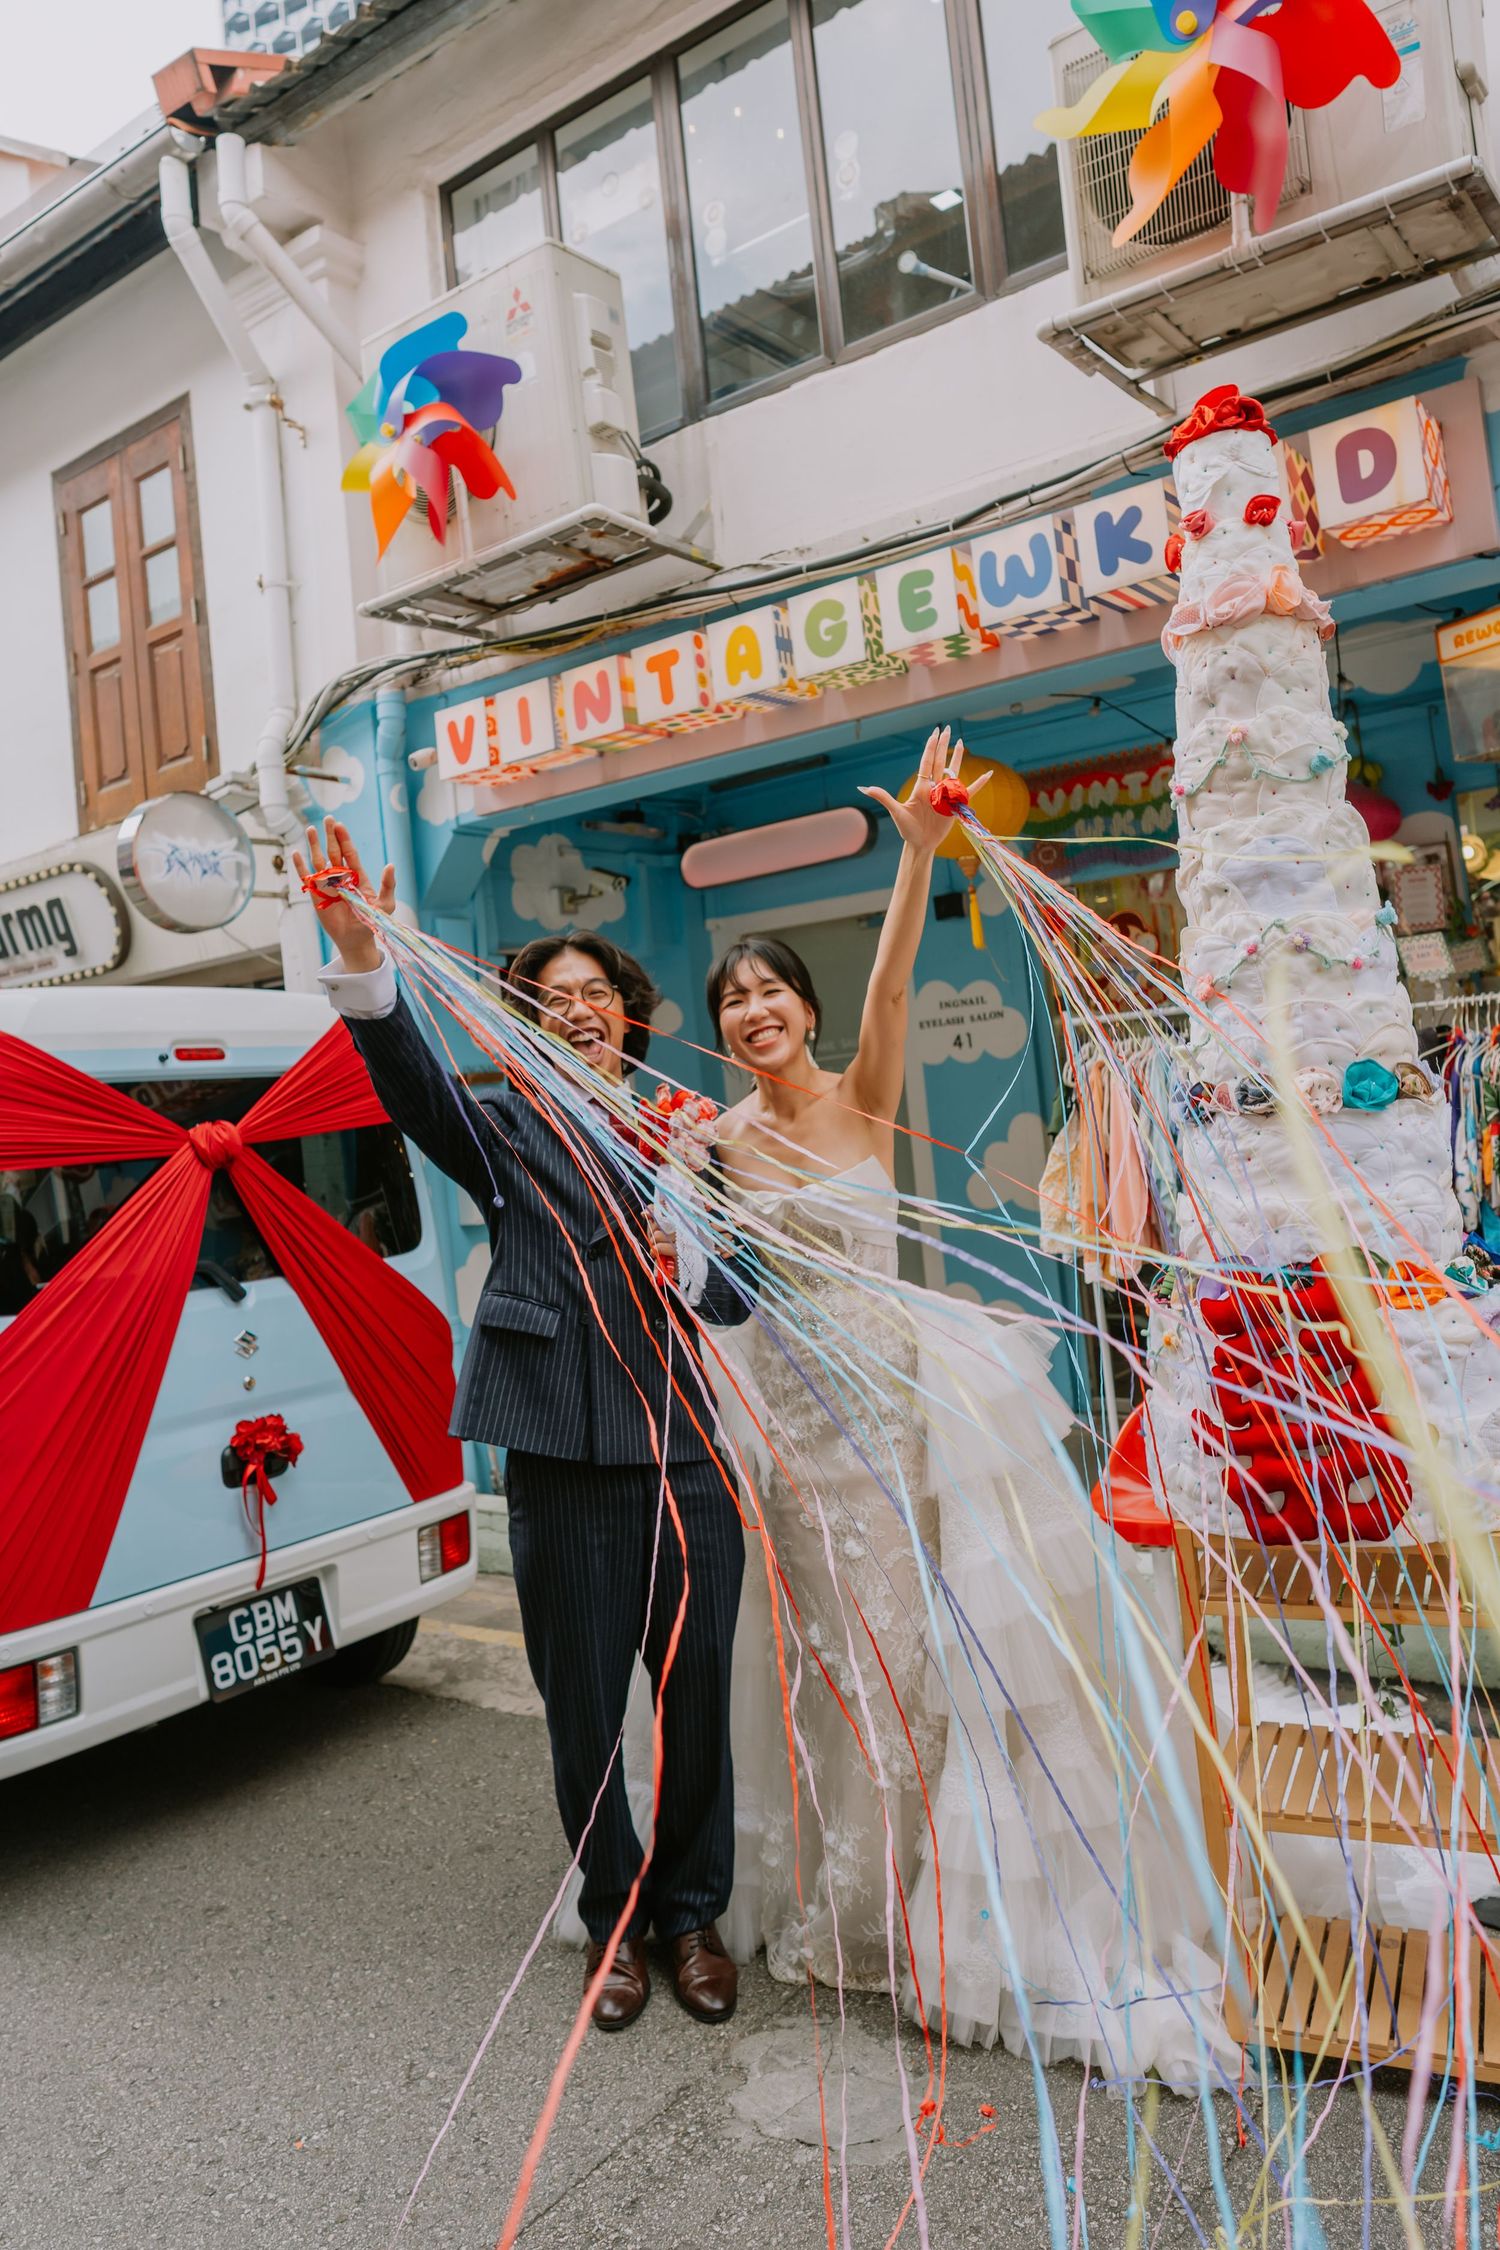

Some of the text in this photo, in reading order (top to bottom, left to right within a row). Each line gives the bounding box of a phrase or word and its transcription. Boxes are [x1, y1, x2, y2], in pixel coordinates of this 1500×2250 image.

[939, 995, 987, 1010] INGNAIL
[919, 1010, 1005, 1031] EYELASH SALON
[953, 1032, 973, 1050] 41
[228, 1590, 299, 1645] GBM
[210, 1615, 323, 1690] 8055 Y
